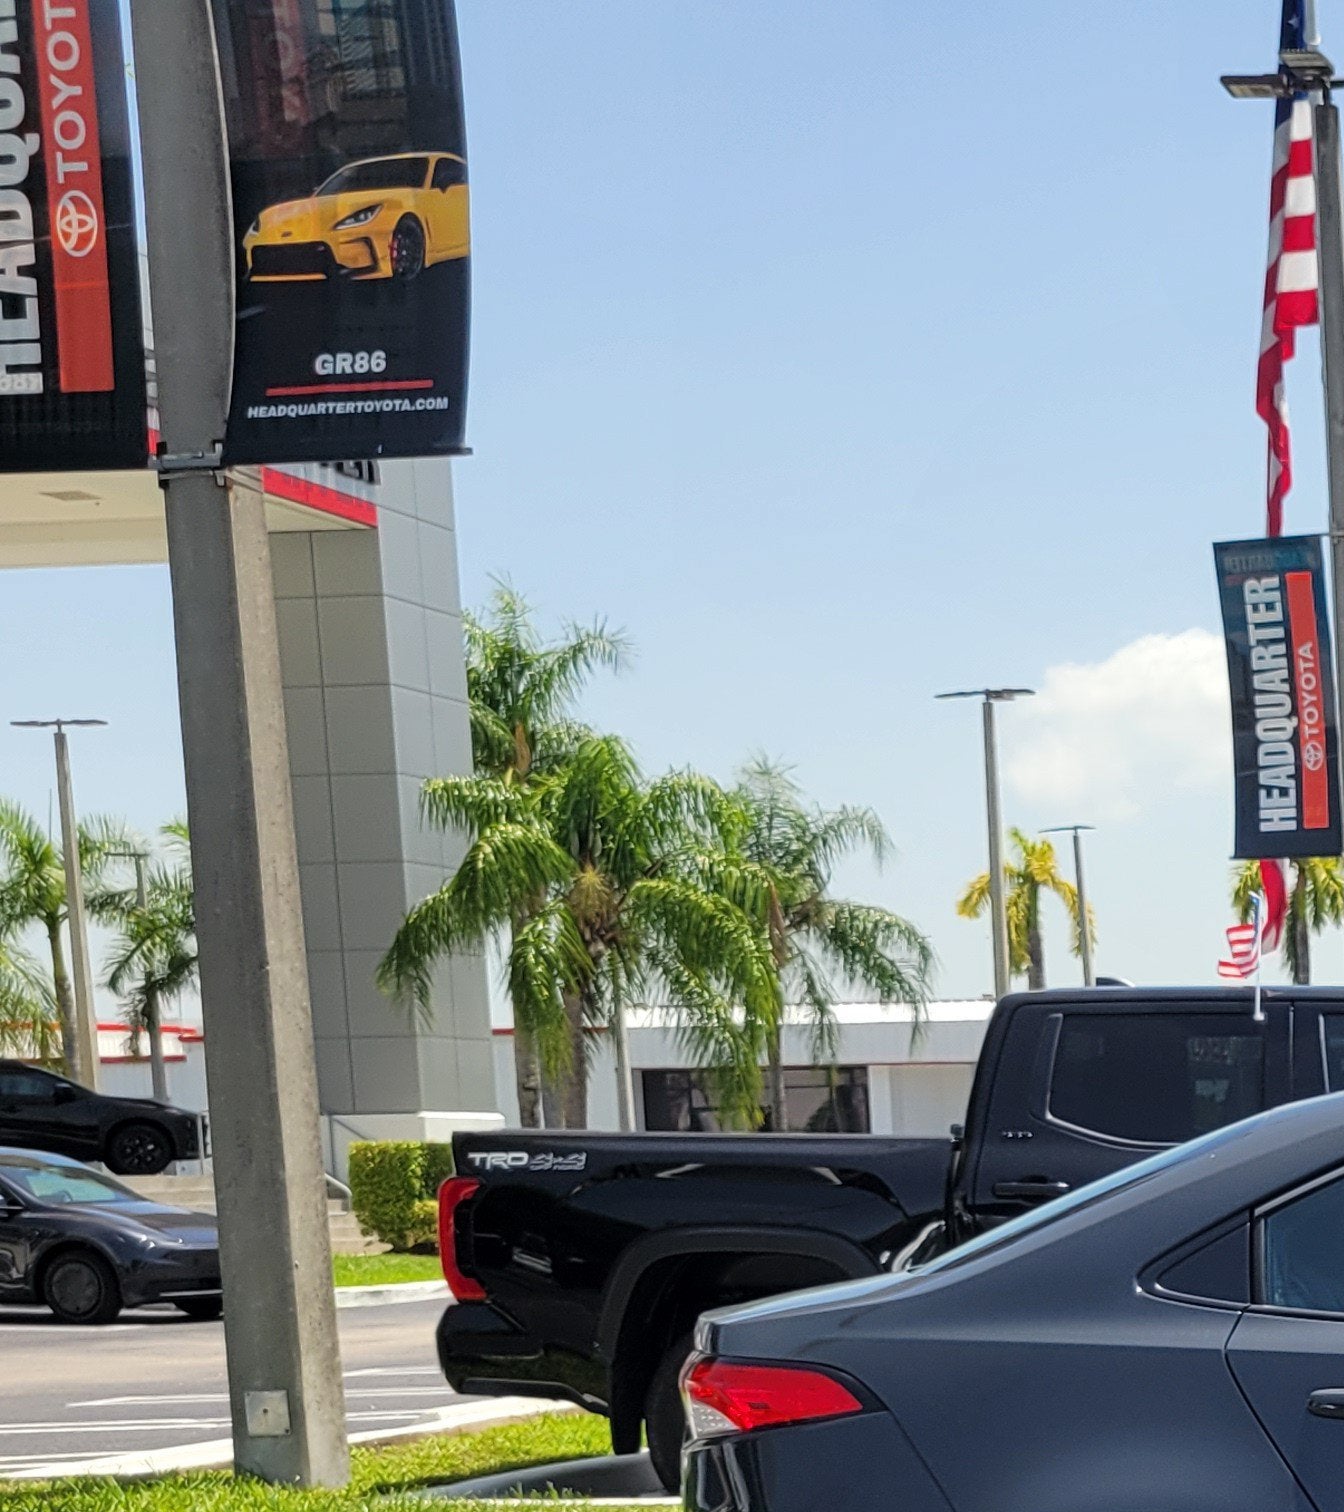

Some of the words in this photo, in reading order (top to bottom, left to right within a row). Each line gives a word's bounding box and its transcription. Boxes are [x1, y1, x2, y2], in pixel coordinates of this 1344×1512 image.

[42, 0, 89, 184] TOYOT
[314, 350, 387, 377] GR86
[247, 397, 449, 420] HEADQUARTERTOYOTA.COM
[1243, 574, 1298, 832] HEADQUARTER
[1299, 641, 1322, 736] TOYOTA
[468, 1152, 529, 1170] TRD
